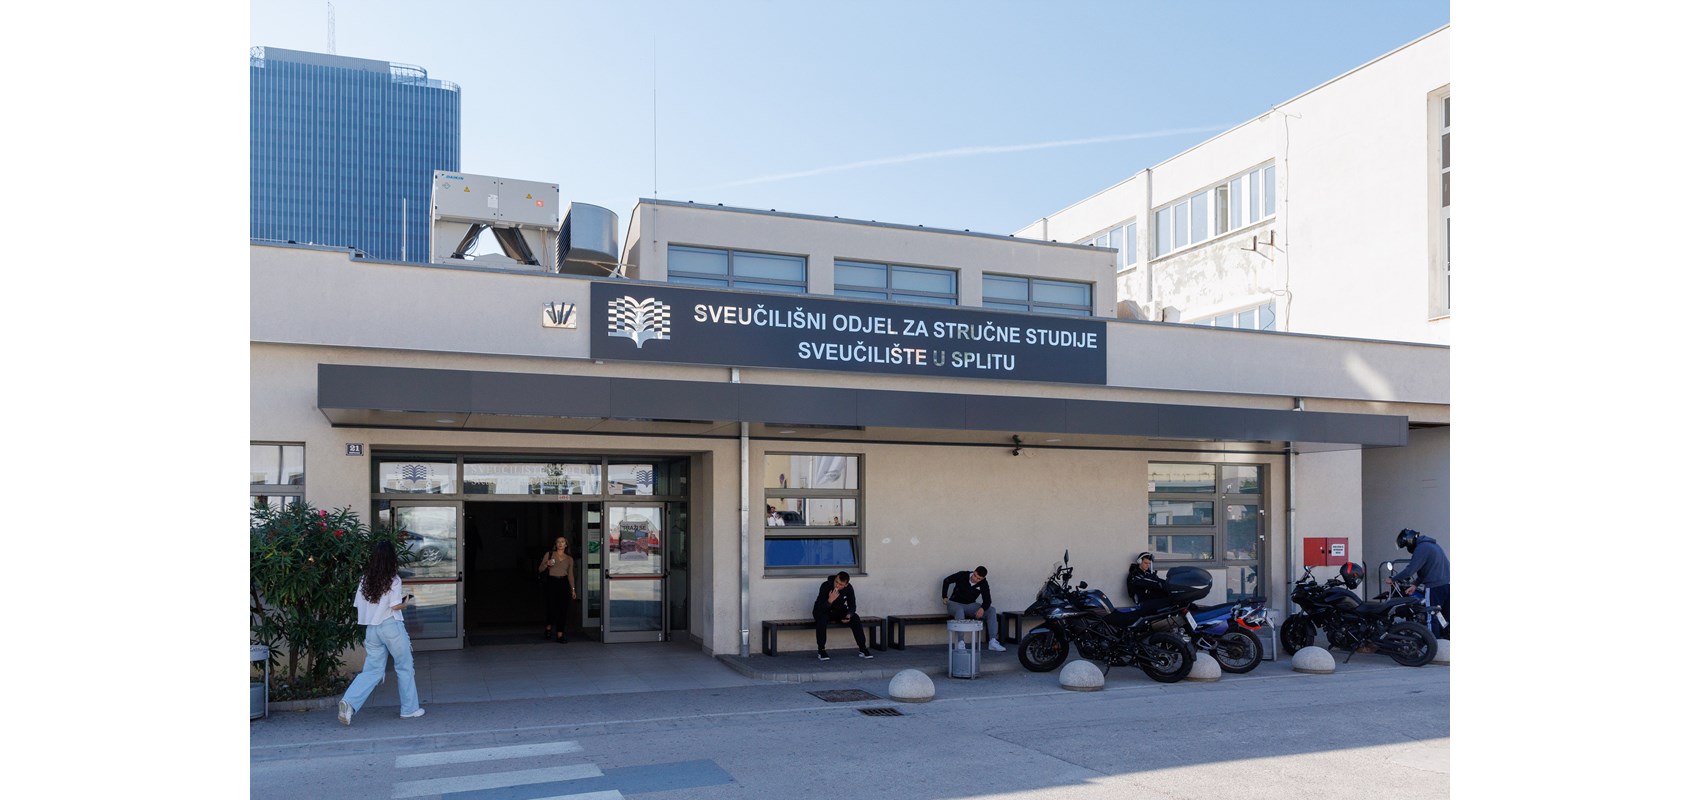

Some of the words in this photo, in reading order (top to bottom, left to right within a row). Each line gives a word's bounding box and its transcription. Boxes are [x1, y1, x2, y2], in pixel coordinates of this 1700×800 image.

[694, 303, 826, 331] SVEUČILIŠNI
[833, 314, 898, 335] ODJEL
[903, 319, 929, 337] ZA
[933, 321, 1020, 343] STRUČNE
[1026, 328, 1098, 348] STUDIJE
[798, 341, 927, 366] SVEUČILIŠTE
[933, 350, 945, 366] U
[952, 351, 1015, 370] SPLITU
